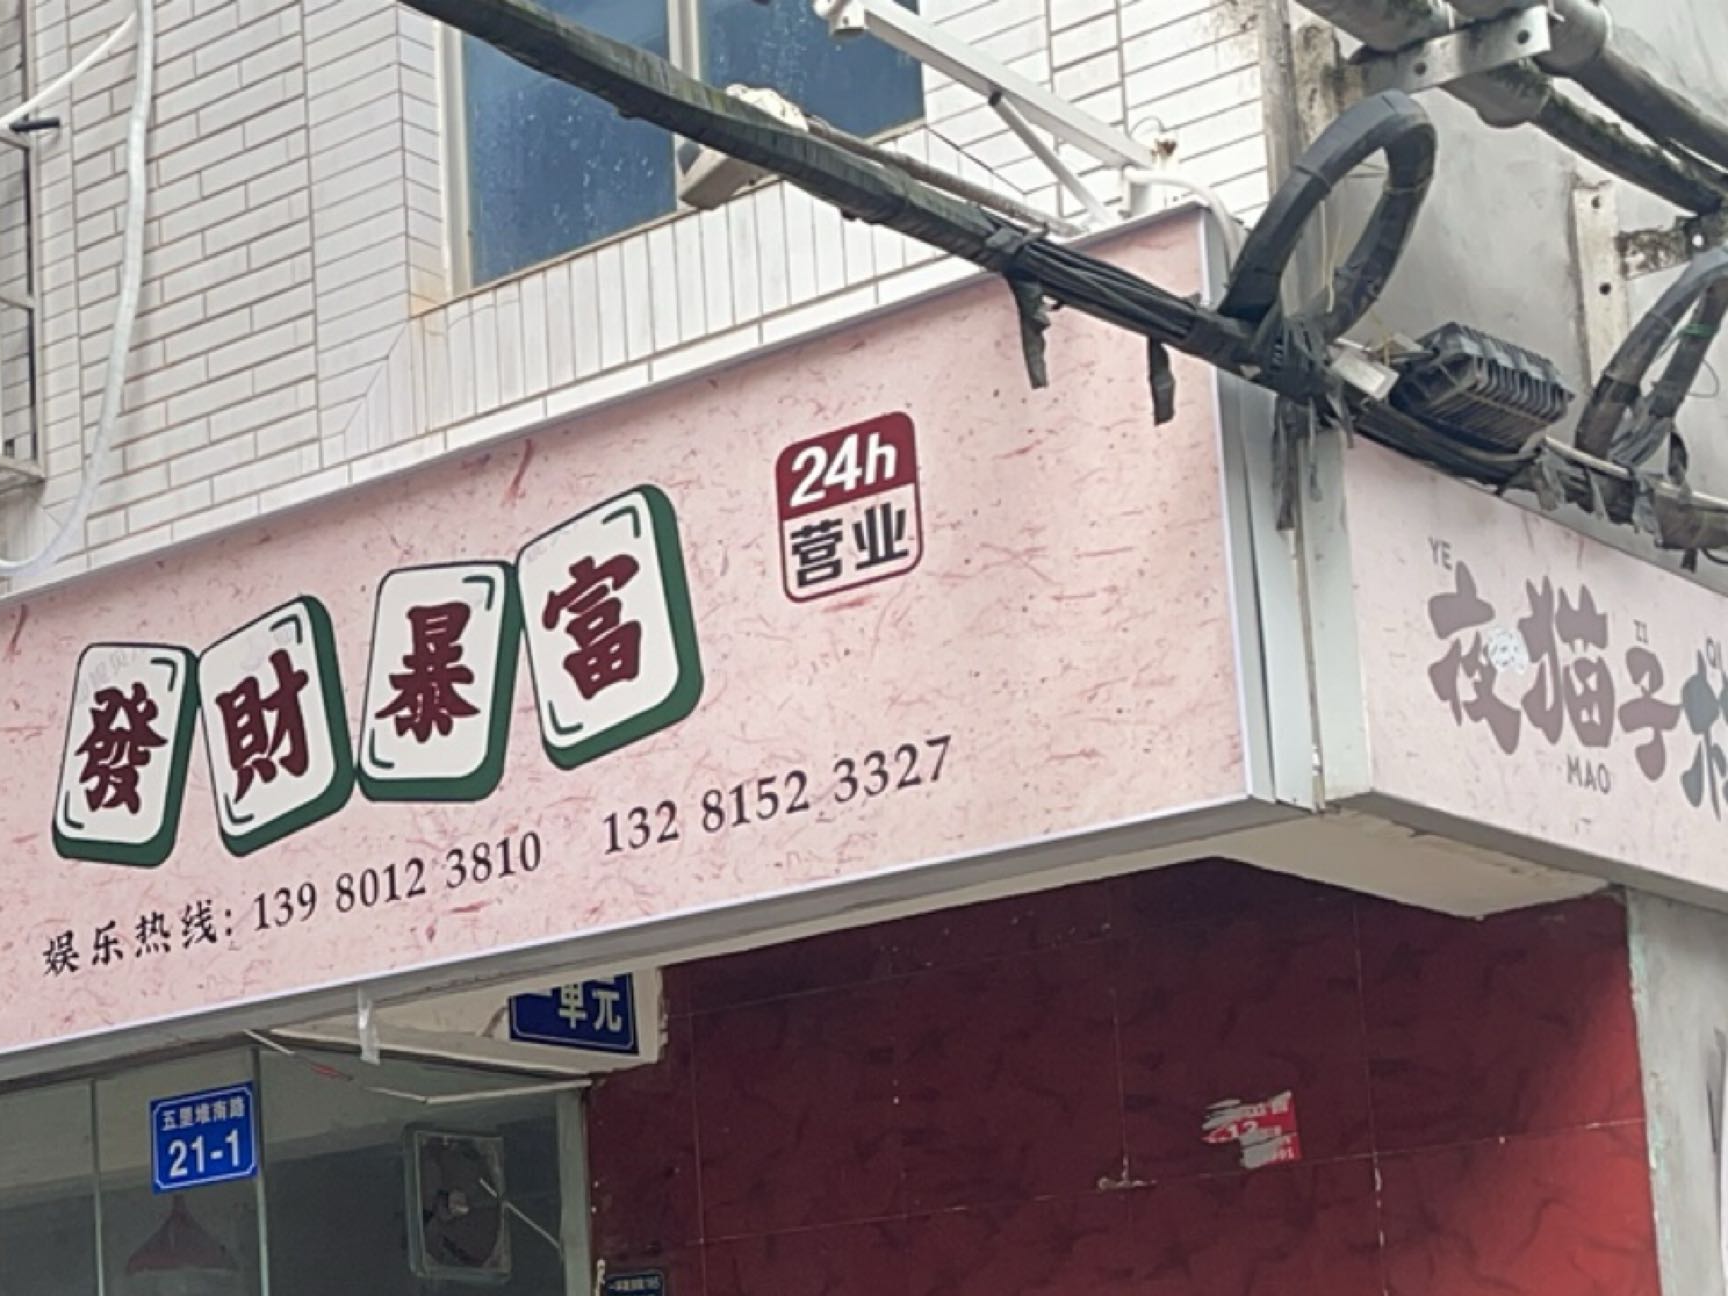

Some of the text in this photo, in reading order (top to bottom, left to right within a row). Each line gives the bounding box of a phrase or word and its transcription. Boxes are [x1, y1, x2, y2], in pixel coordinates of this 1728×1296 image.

[788, 433, 897, 507] 24h
[790, 502, 910, 588] 营业
[1428, 536, 1453, 571] YE
[1633, 619, 1649, 643] ZI
[75, 553, 643, 815] 發財暴富
[1567, 754, 1612, 795] MAO
[253, 882, 317, 931] 139
[335, 857, 426, 912] 8012
[445, 831, 542, 890] 3810
[603, 799, 680, 854] 132
[702, 769, 810, 834] 8152
[833, 735, 952, 804] 3327
[557, 979, 622, 1032] 单元
[168, 1128, 240, 1177] 21-1
